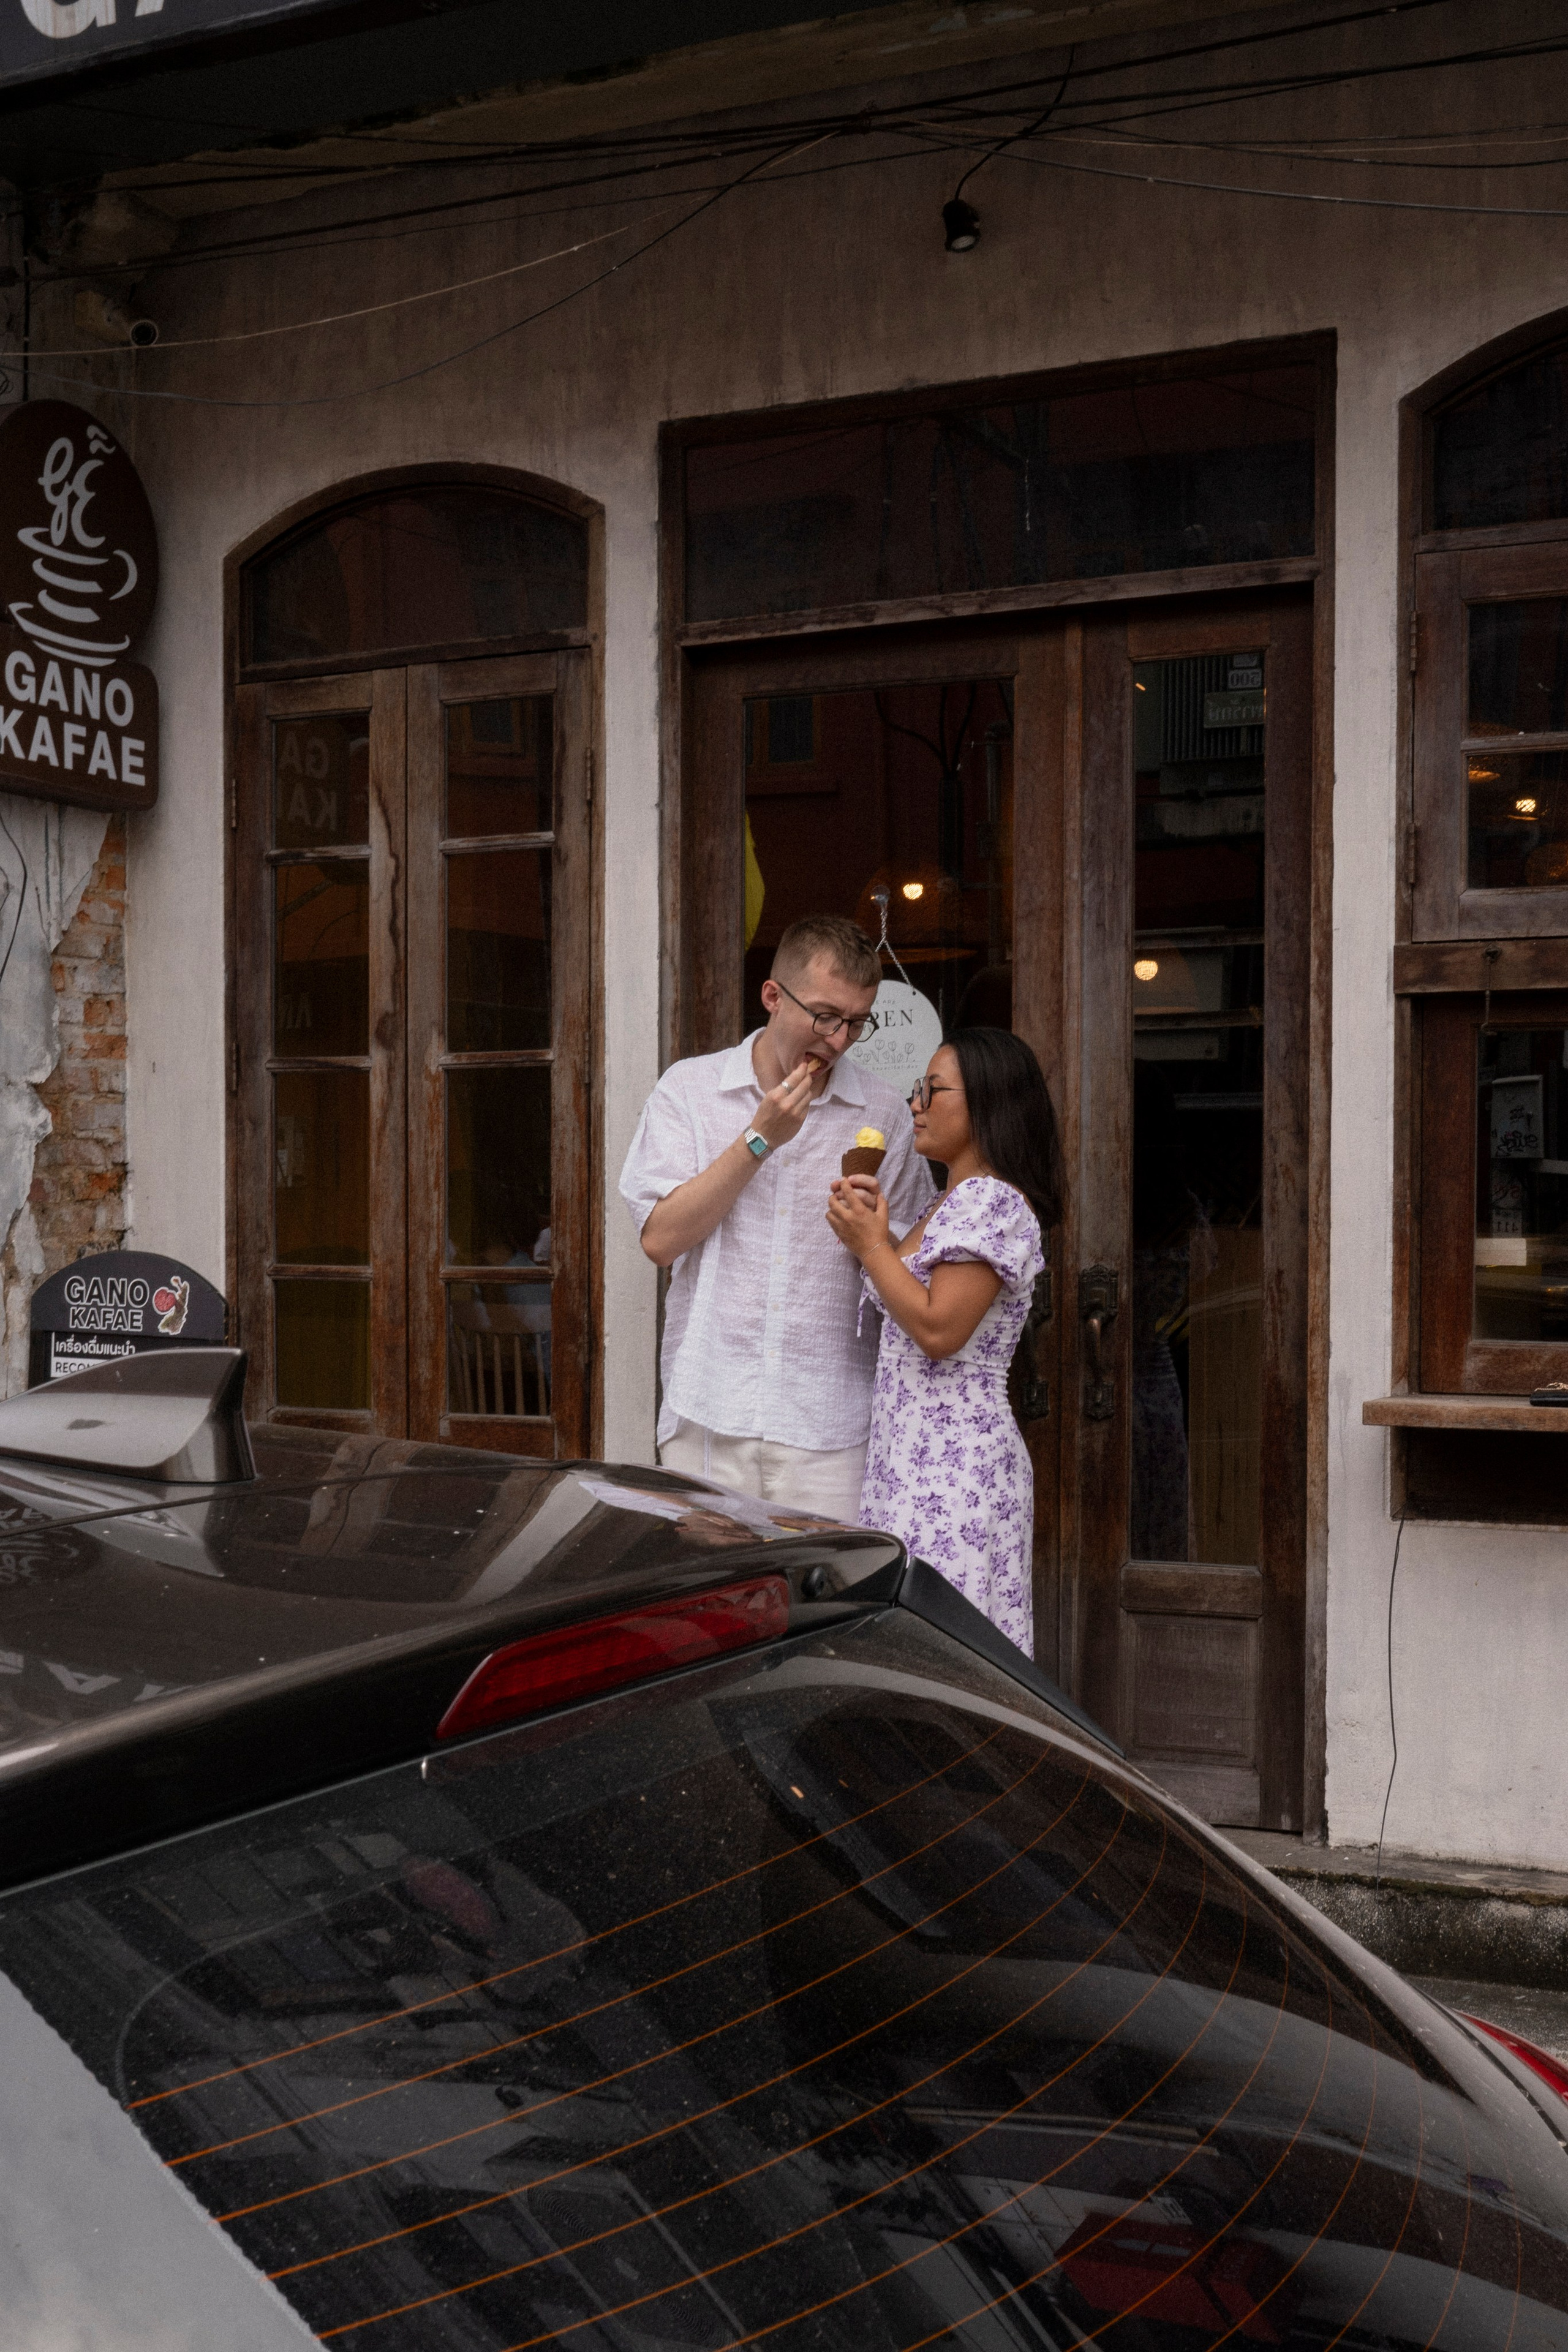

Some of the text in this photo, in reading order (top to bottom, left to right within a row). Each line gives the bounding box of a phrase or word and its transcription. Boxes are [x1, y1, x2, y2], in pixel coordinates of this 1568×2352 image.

[5, 650, 134, 728] GANO
[0, 704, 146, 786] KAFAE
[65, 1275, 150, 1308] GANO
[69, 1306, 144, 1332] KAFAE
[56, 1334, 136, 1355] เครื่องดื่มแนะนำ
